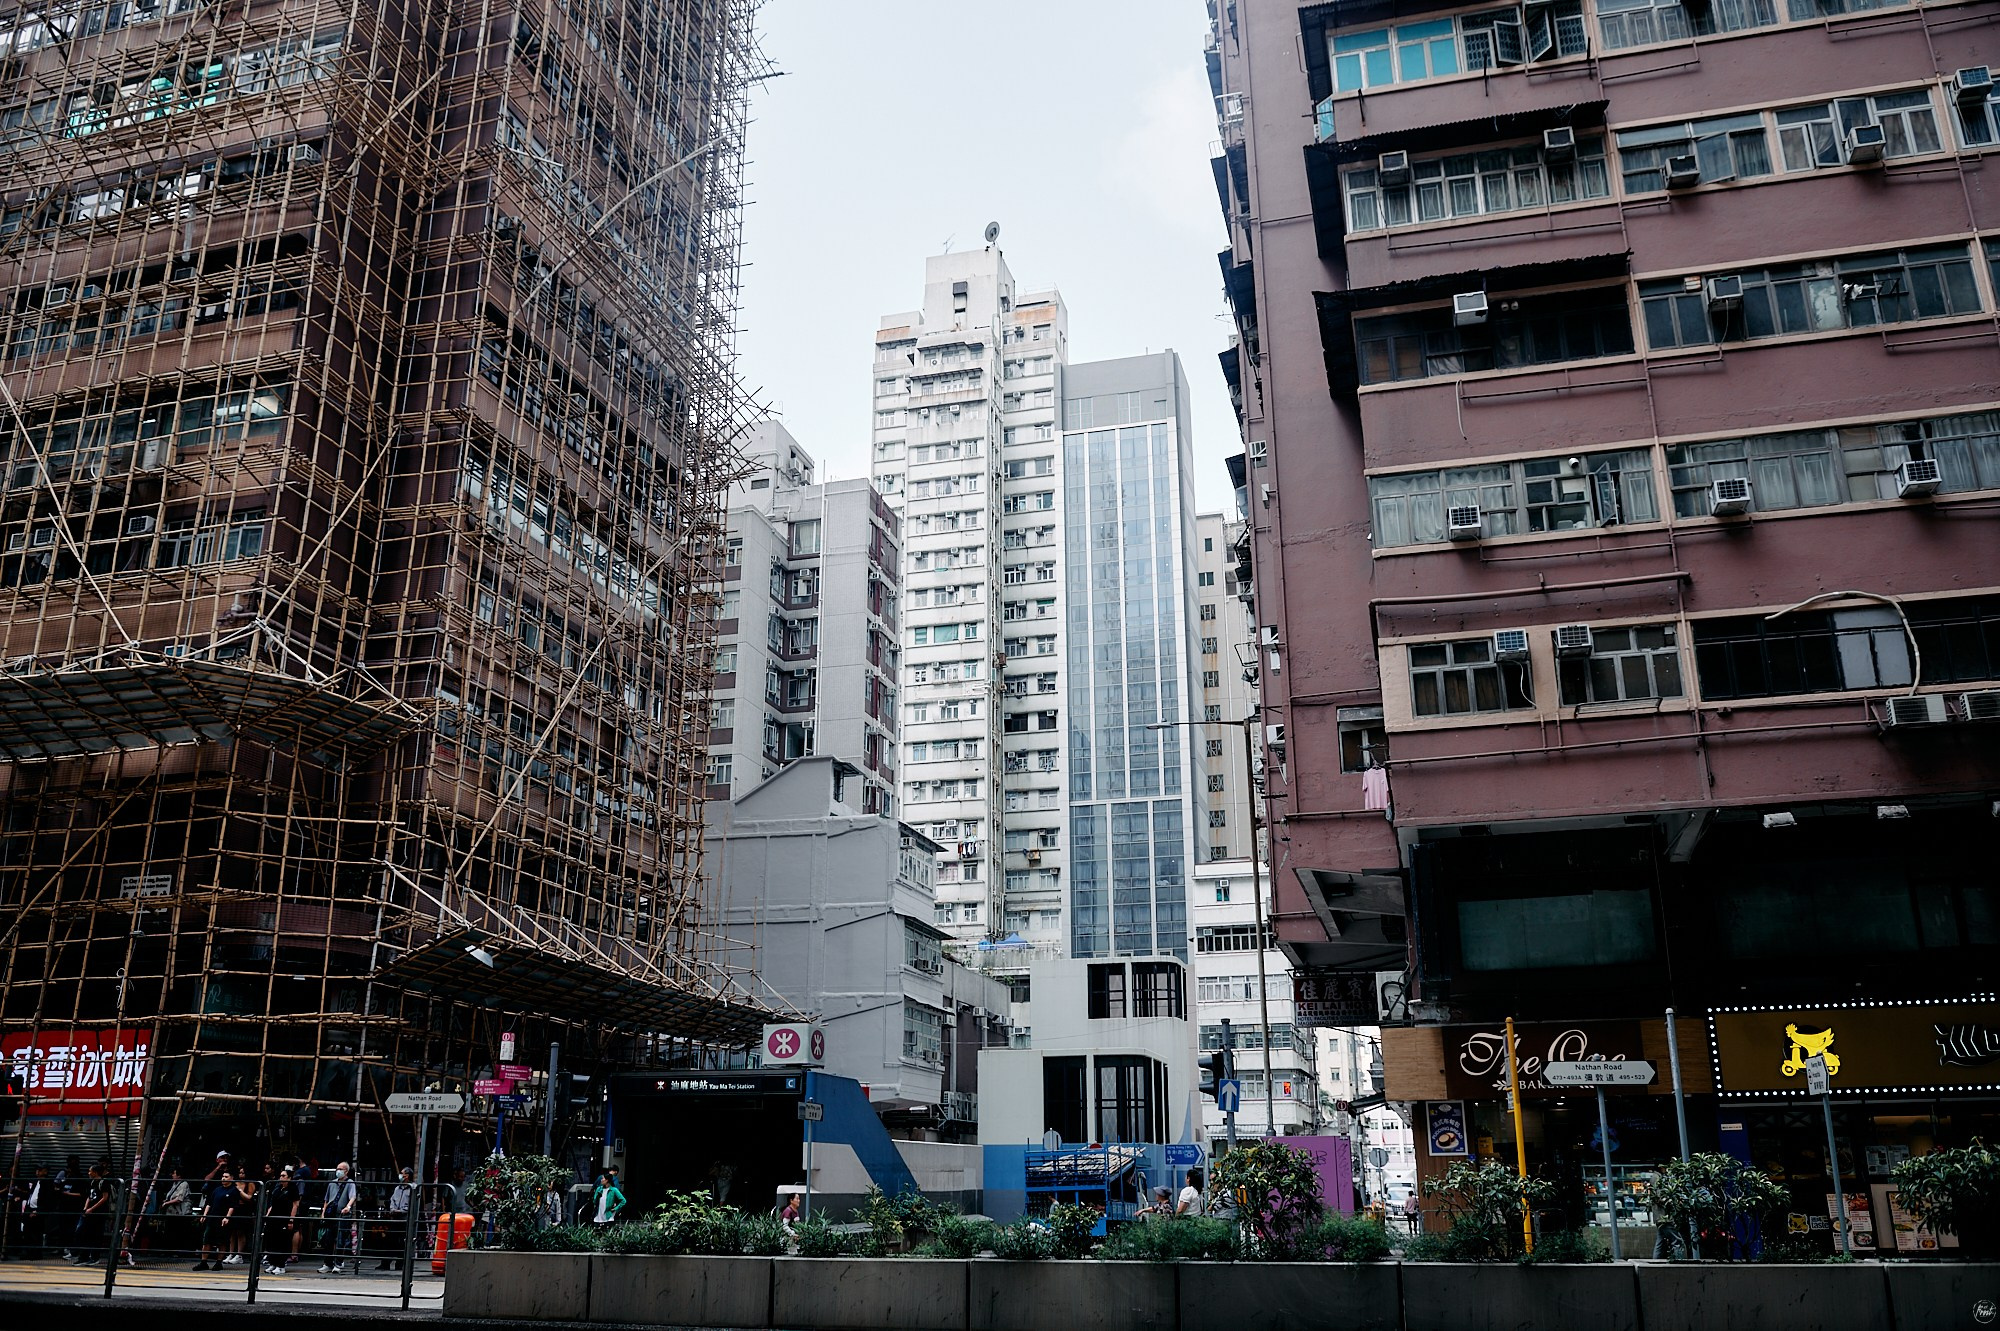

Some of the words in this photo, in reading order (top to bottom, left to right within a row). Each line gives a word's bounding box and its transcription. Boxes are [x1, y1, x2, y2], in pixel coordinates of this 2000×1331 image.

[1323, 1002, 1341, 1010] LAI
[11, 1044, 147, 1088] 蜜雪冰城
[1584, 1074, 1615, 1082] 彌敦道
[670, 1080, 708, 1090] 油麻地站
[788, 1080, 794, 1088] C
[1520, 1080, 1571, 1089] BAK
